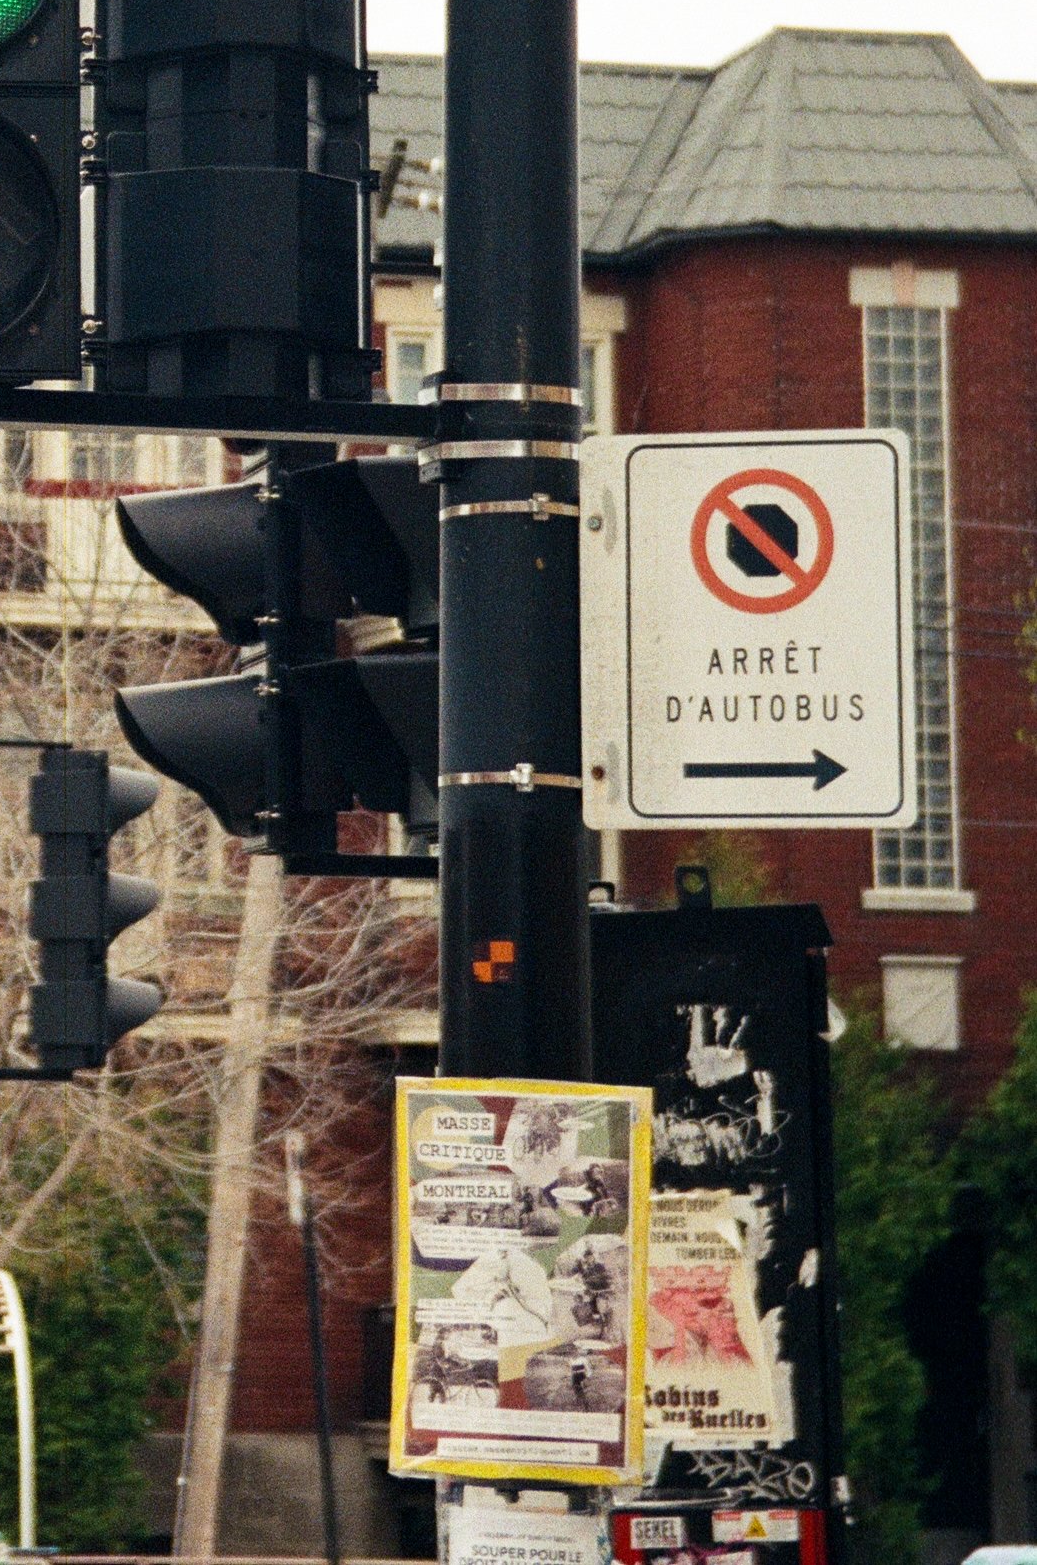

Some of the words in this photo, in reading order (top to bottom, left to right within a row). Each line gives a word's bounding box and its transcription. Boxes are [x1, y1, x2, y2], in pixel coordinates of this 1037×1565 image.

[707, 641, 822, 675] ARRÊT
[666, 694, 865, 723] D'AUTOBUS
[437, 1116, 492, 1131] MASSE
[419, 1143, 506, 1162] CRITIQUE
[422, 1185, 509, 1199] MONTREAL
[471, 1544, 526, 1559] SOUPER
[530, 1548, 566, 1562] POUR
[568, 1551, 583, 1563] LE
